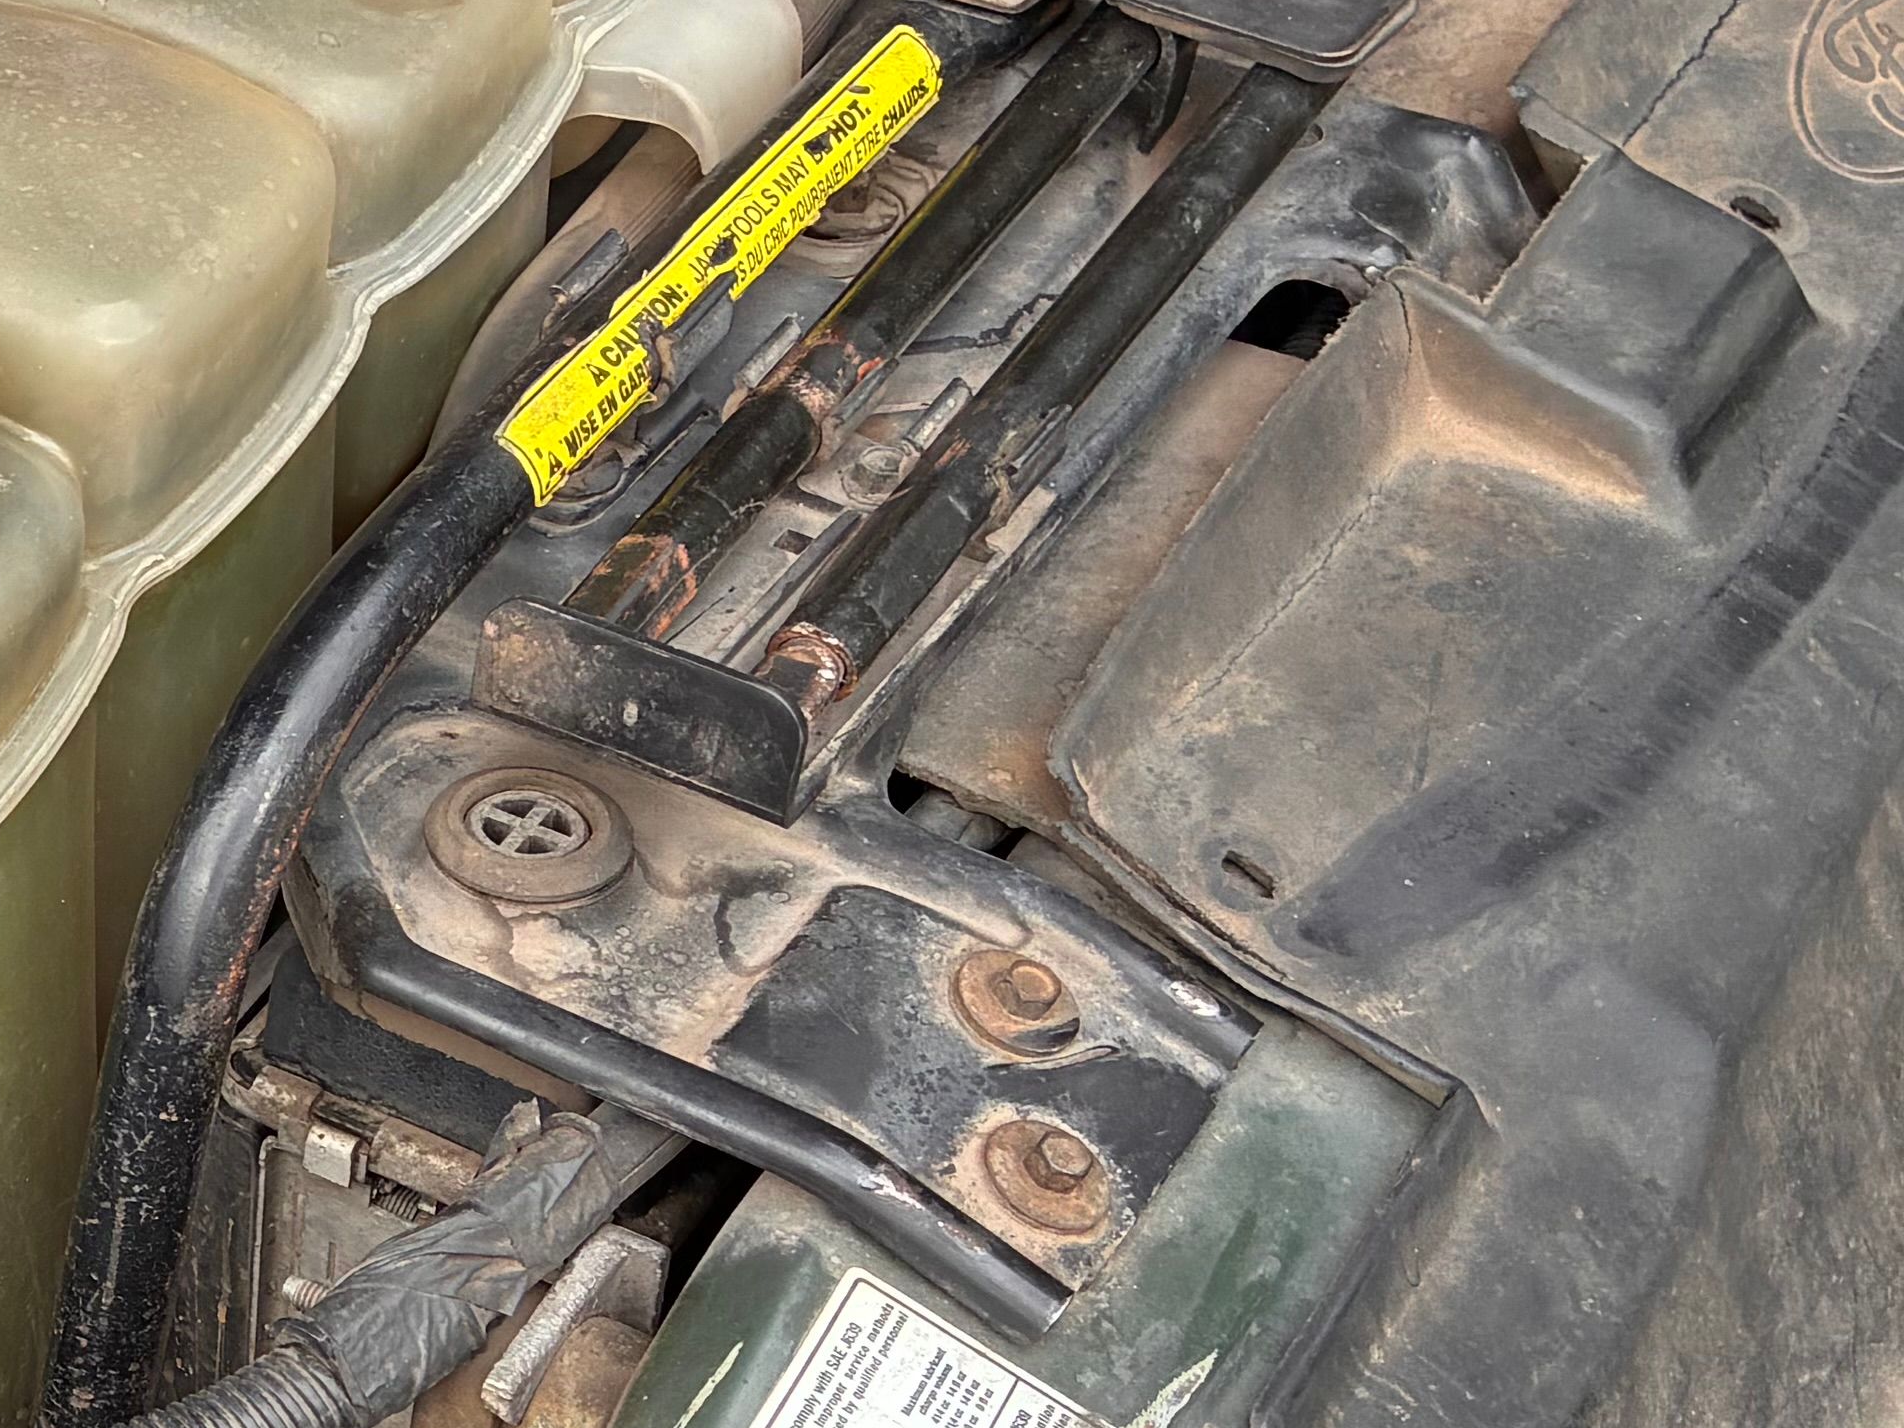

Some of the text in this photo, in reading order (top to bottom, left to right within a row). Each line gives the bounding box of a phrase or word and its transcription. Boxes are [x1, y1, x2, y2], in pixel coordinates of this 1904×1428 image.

[726, 188, 781, 245] TOOLS
[772, 154, 810, 197] MAY
[828, 95, 873, 144] HOT.
[738, 243, 764, 274] DU
[757, 216, 795, 256] CRIC
[789, 149, 863, 225] POURRAIENT
[589, 390, 618, 425] EN
[813, 1370, 835, 1395] with
[825, 1345, 848, 1371] SAE
